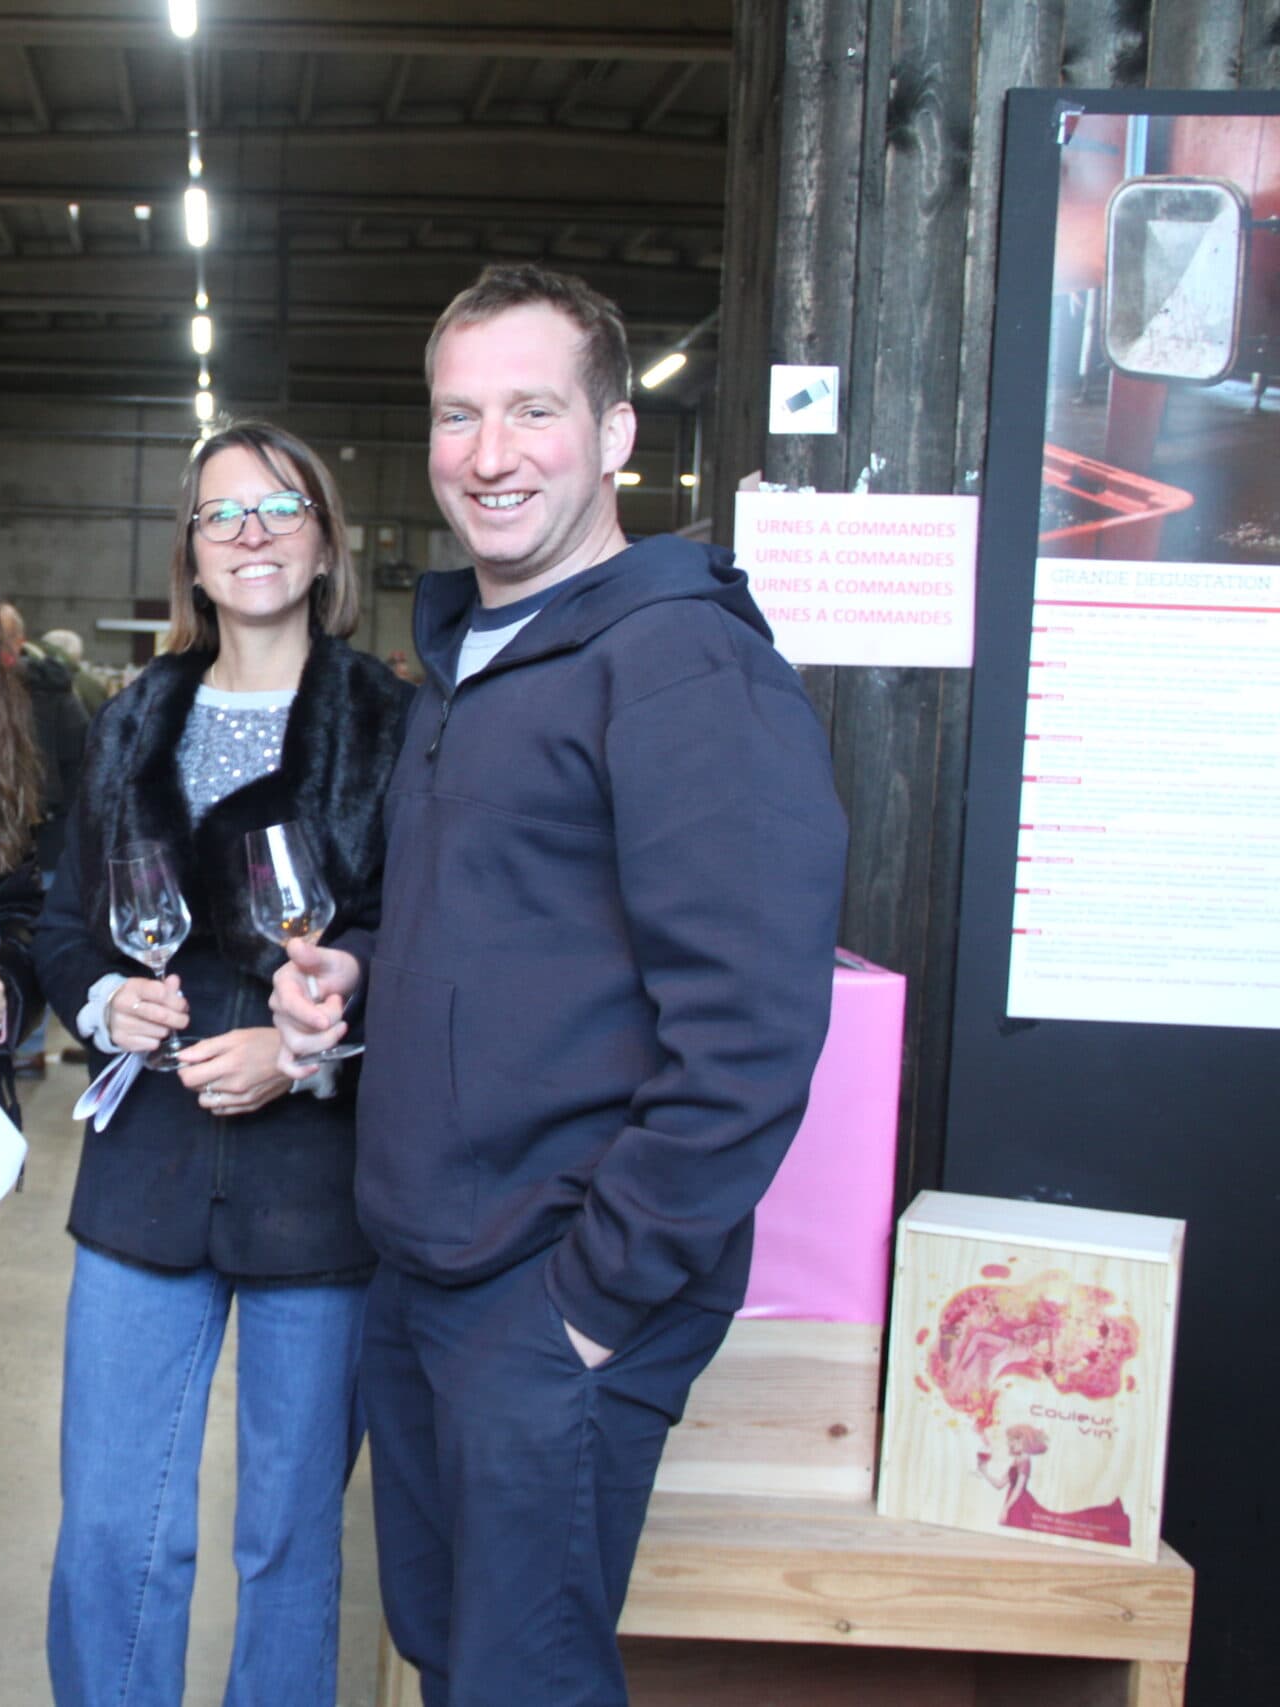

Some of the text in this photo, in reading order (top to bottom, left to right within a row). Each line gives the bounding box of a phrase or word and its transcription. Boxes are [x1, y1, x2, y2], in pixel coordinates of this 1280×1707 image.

[756, 519, 956, 538] URNES A COMMANDES
[755, 549, 955, 567] URNES A COMMANDES
[1051, 569, 1129, 587] GRANDE
[754, 578, 954, 597] URNES A COMMANDES
[815, 608, 828, 623] A
[832, 608, 953, 626] COMMANDES
[1029, 1404, 1112, 1425] Couleur
